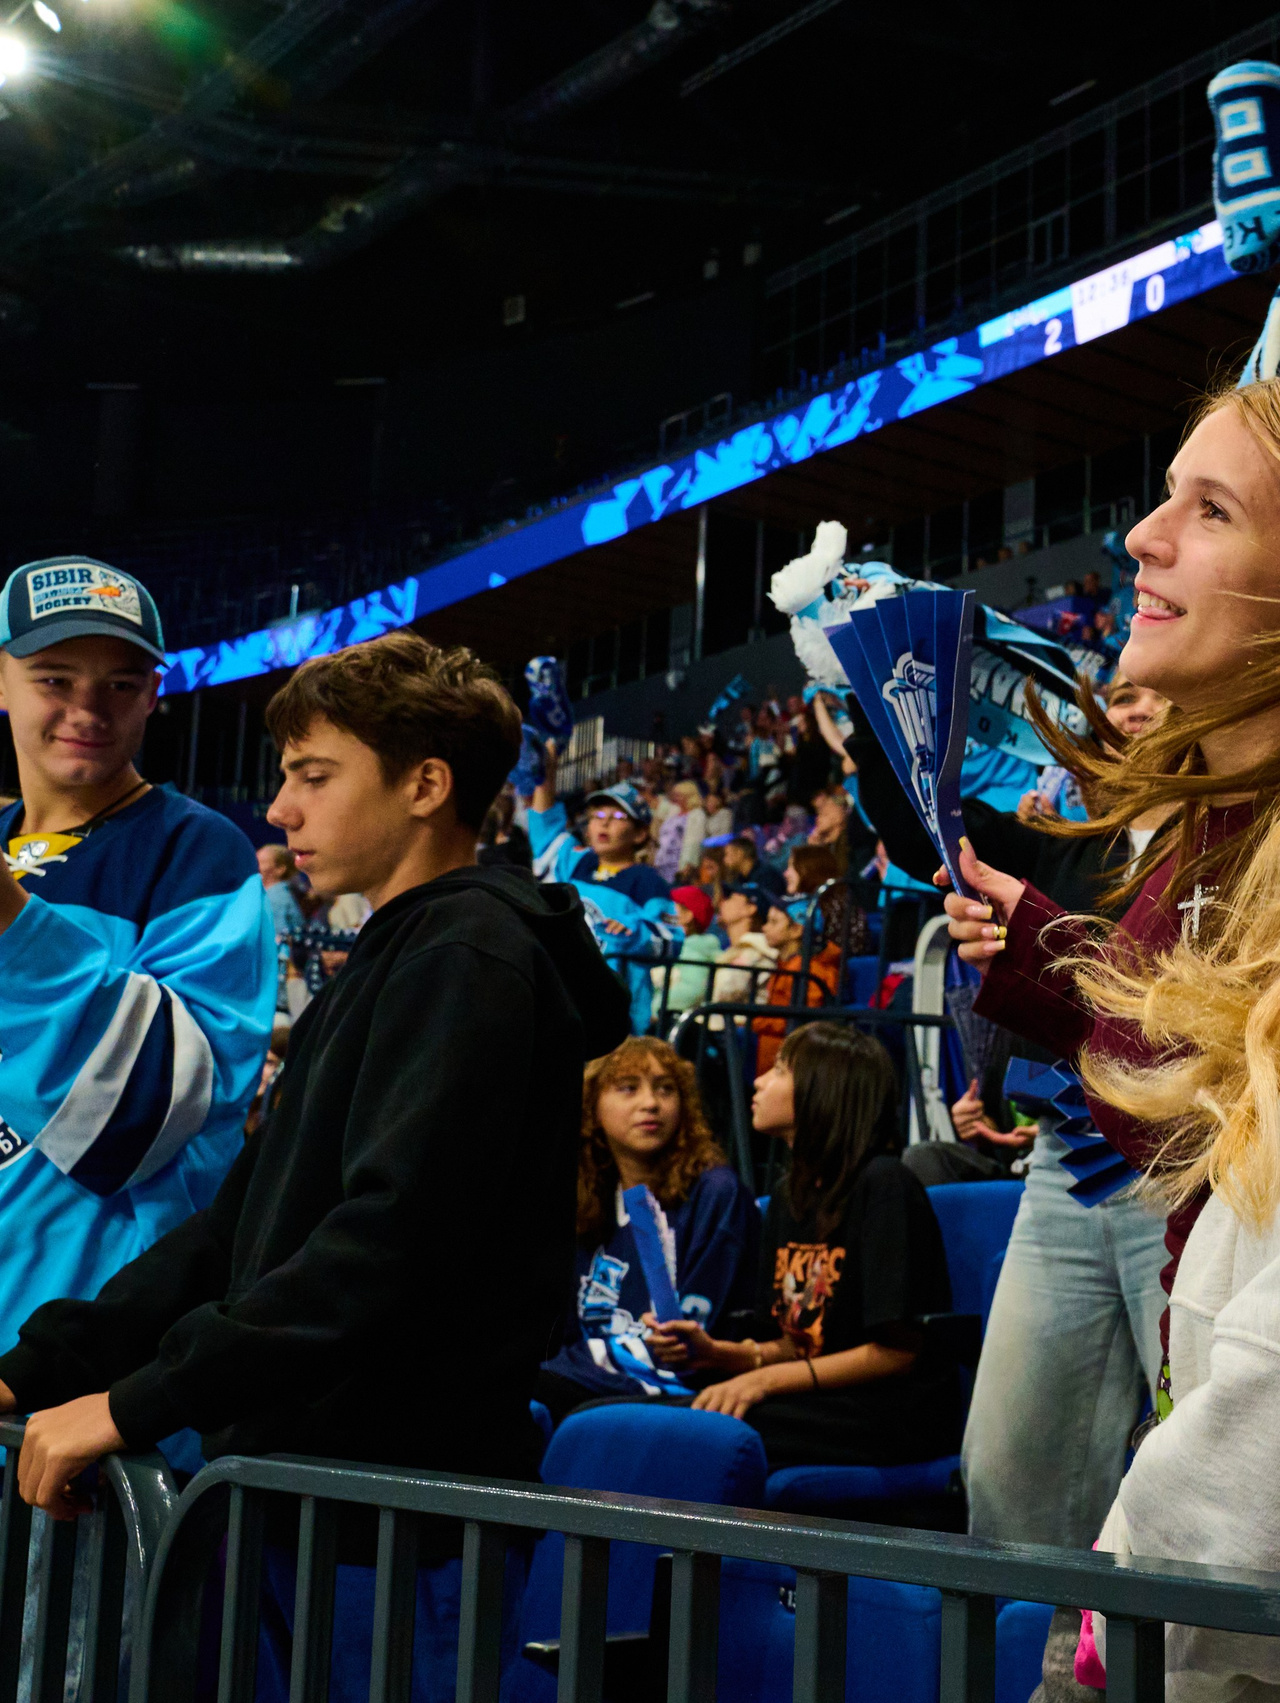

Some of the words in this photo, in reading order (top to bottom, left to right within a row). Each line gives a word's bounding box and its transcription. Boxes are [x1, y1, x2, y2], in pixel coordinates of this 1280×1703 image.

[1146, 273, 1165, 313] 0
[1044, 317, 1063, 356] 2
[32, 568, 94, 592] SIBIR
[35, 596, 92, 614] HOCKEY
